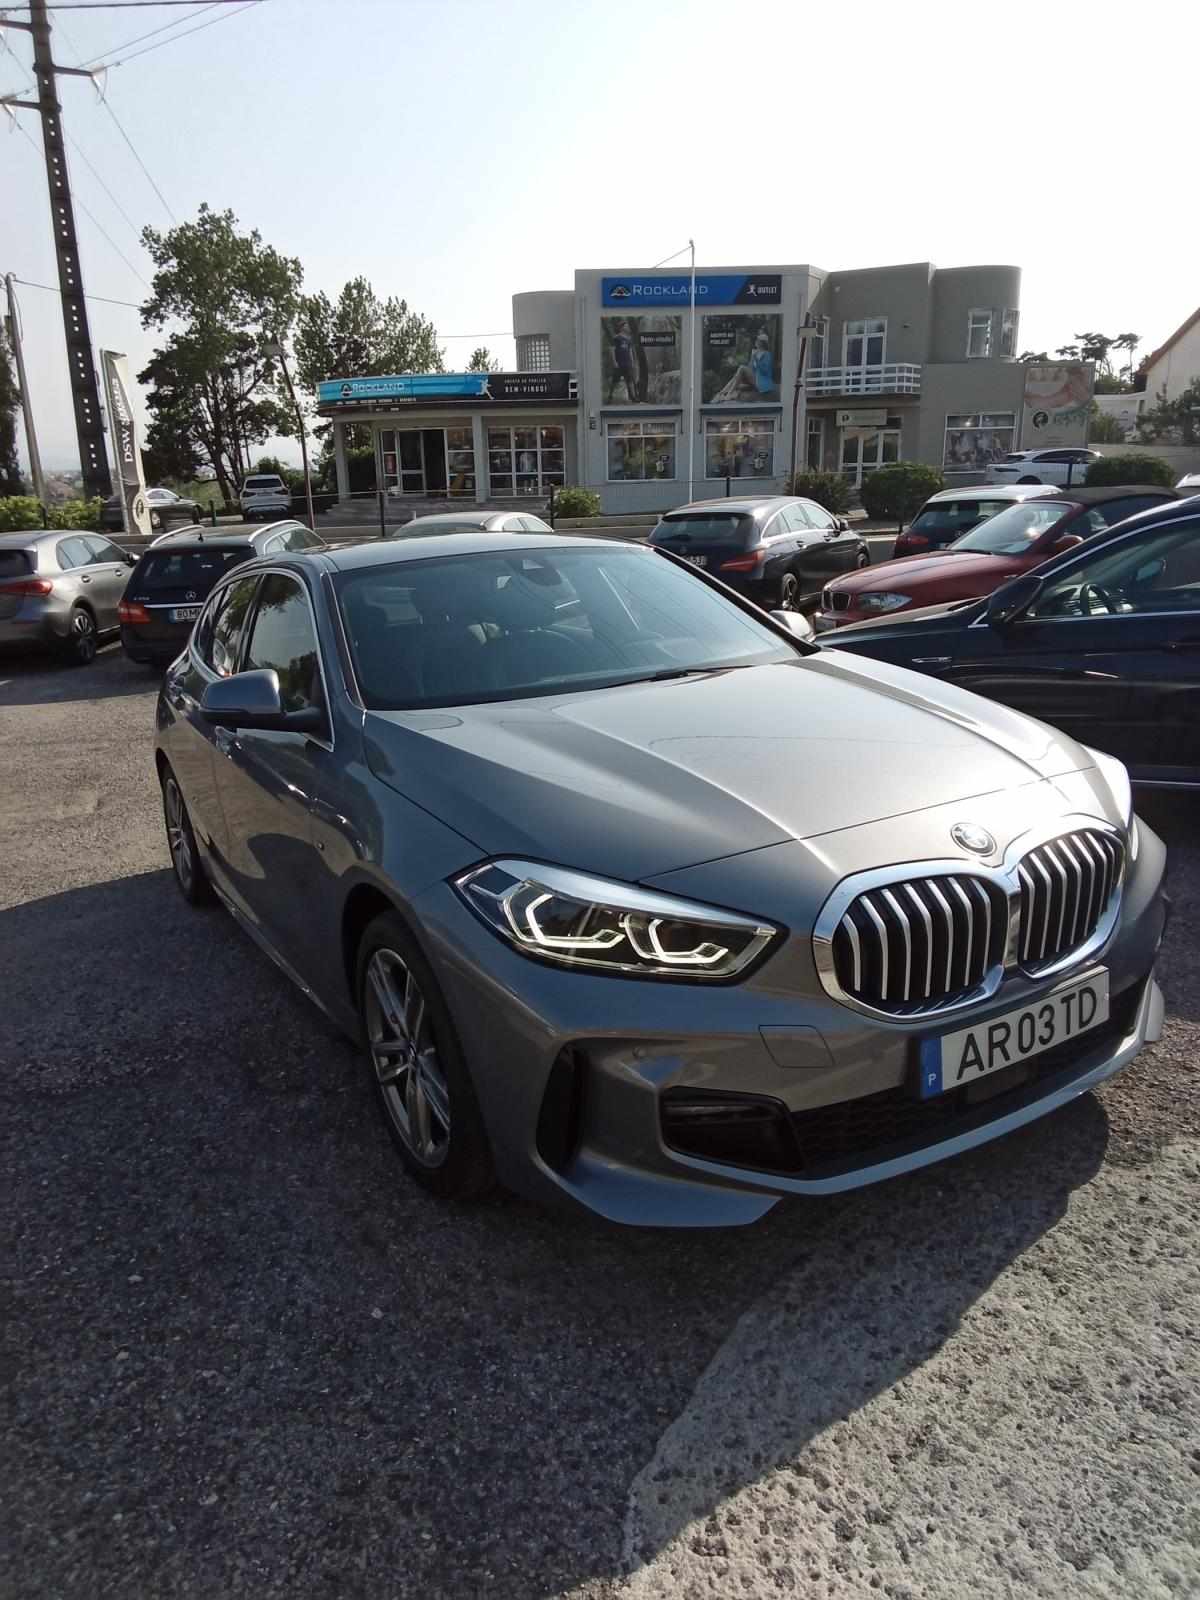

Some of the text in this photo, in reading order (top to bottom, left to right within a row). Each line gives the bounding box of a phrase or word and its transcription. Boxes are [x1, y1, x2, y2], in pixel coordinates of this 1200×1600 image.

[632, 284, 709, 296] ROCKLAND
[352, 382, 405, 393] ROCKLAND
[121, 428, 134, 463] DSW
[928, 1073, 937, 1087] P
